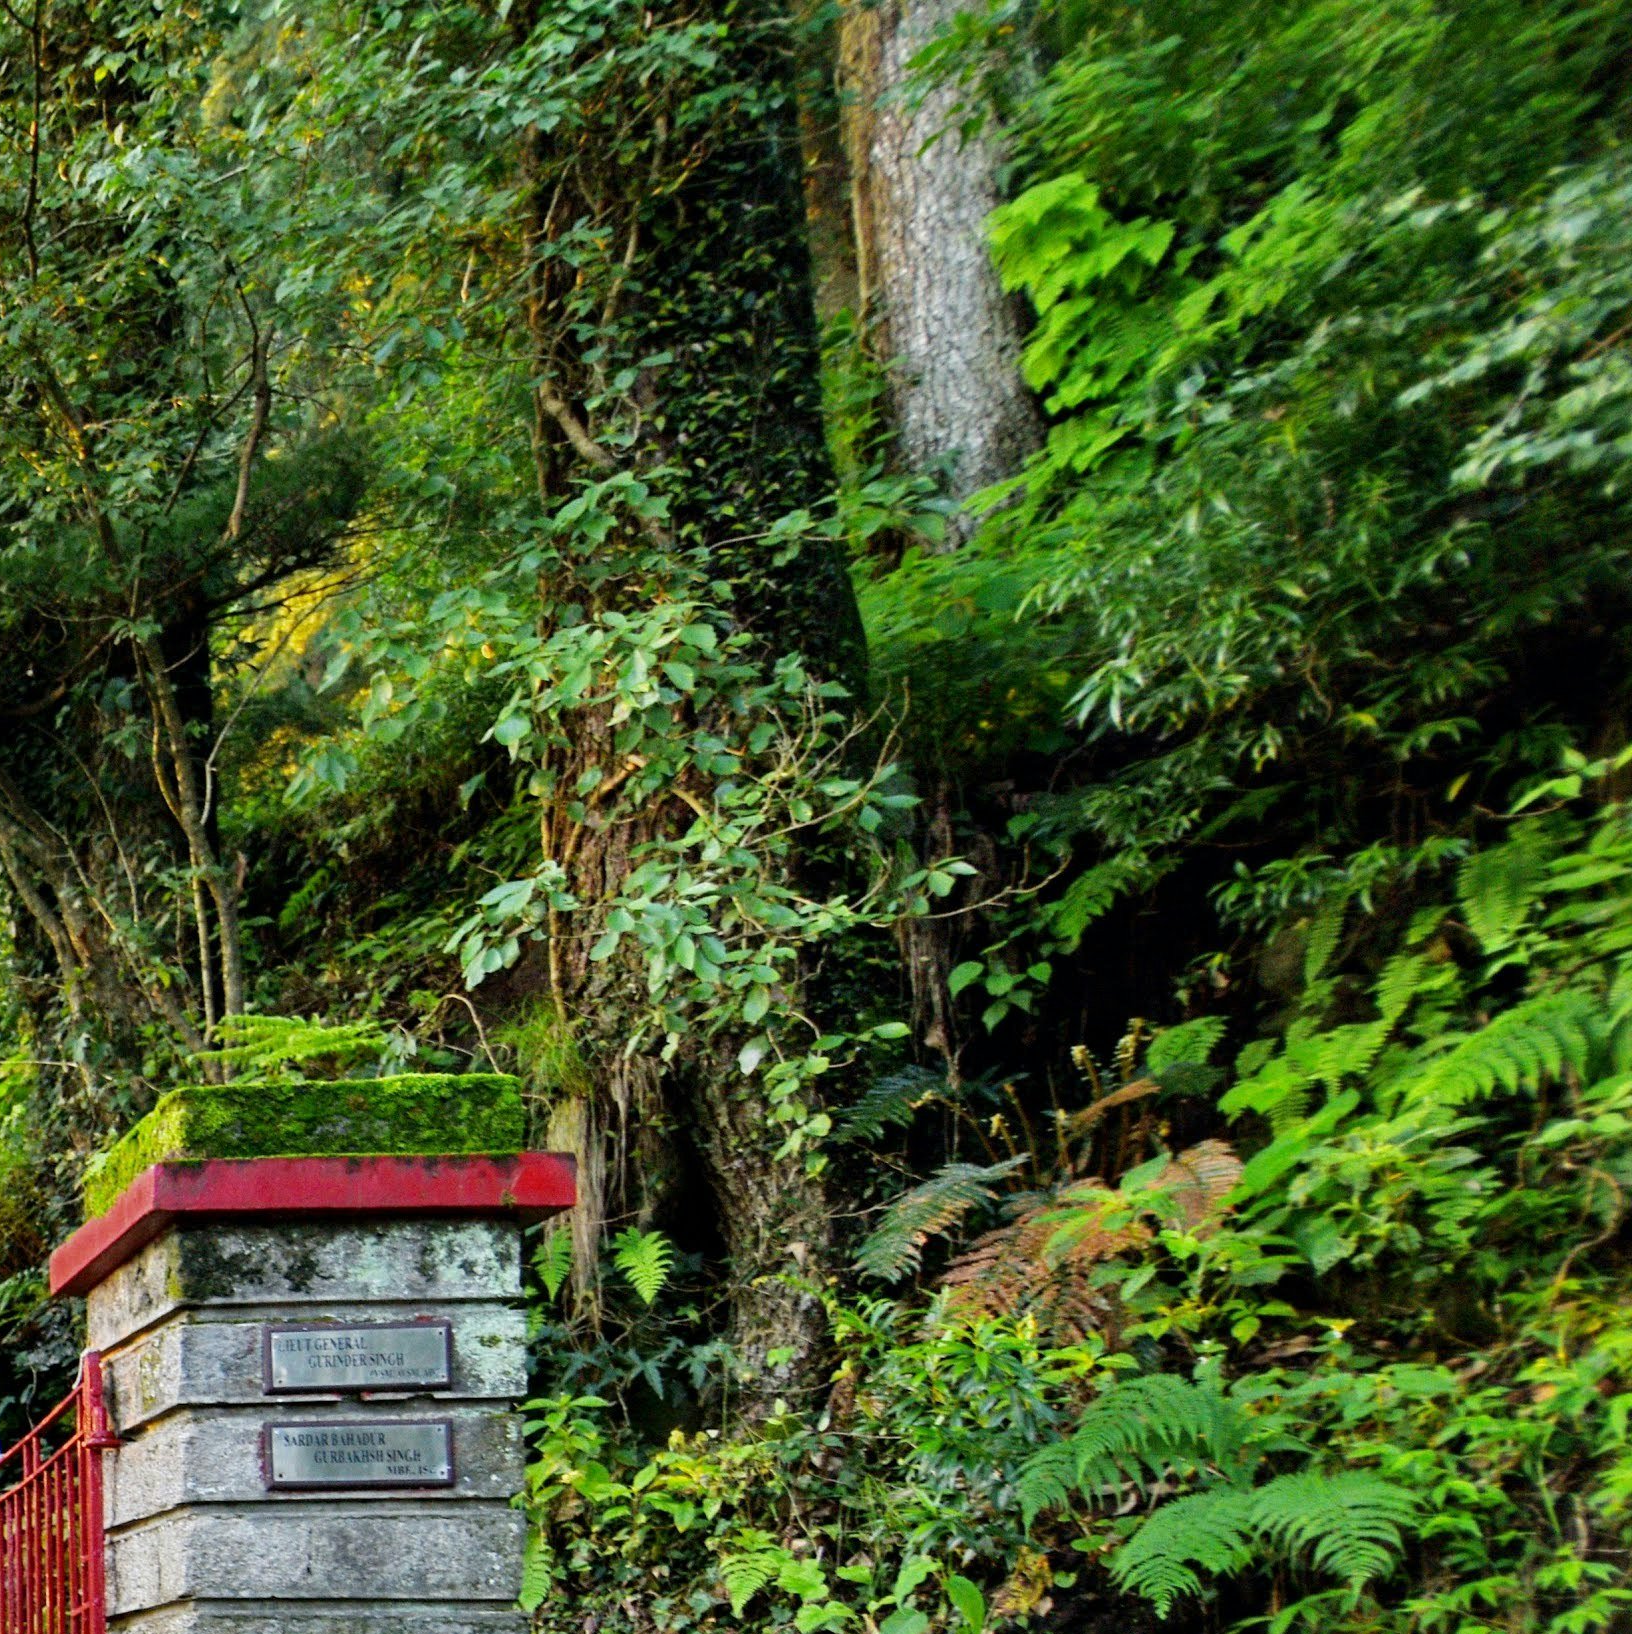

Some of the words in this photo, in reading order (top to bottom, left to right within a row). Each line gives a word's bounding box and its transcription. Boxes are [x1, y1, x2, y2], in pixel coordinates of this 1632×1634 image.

[314, 1337, 368, 1351] GENERAL
[308, 1354, 367, 1368] GURINDER
[369, 1353, 405, 1367] SINGH
[283, 1434, 329, 1447] SARDAR
[331, 1432, 386, 1447] BAHADUR
[314, 1450, 384, 1463] GURBAKHSH
[386, 1449, 421, 1463] SINGH
